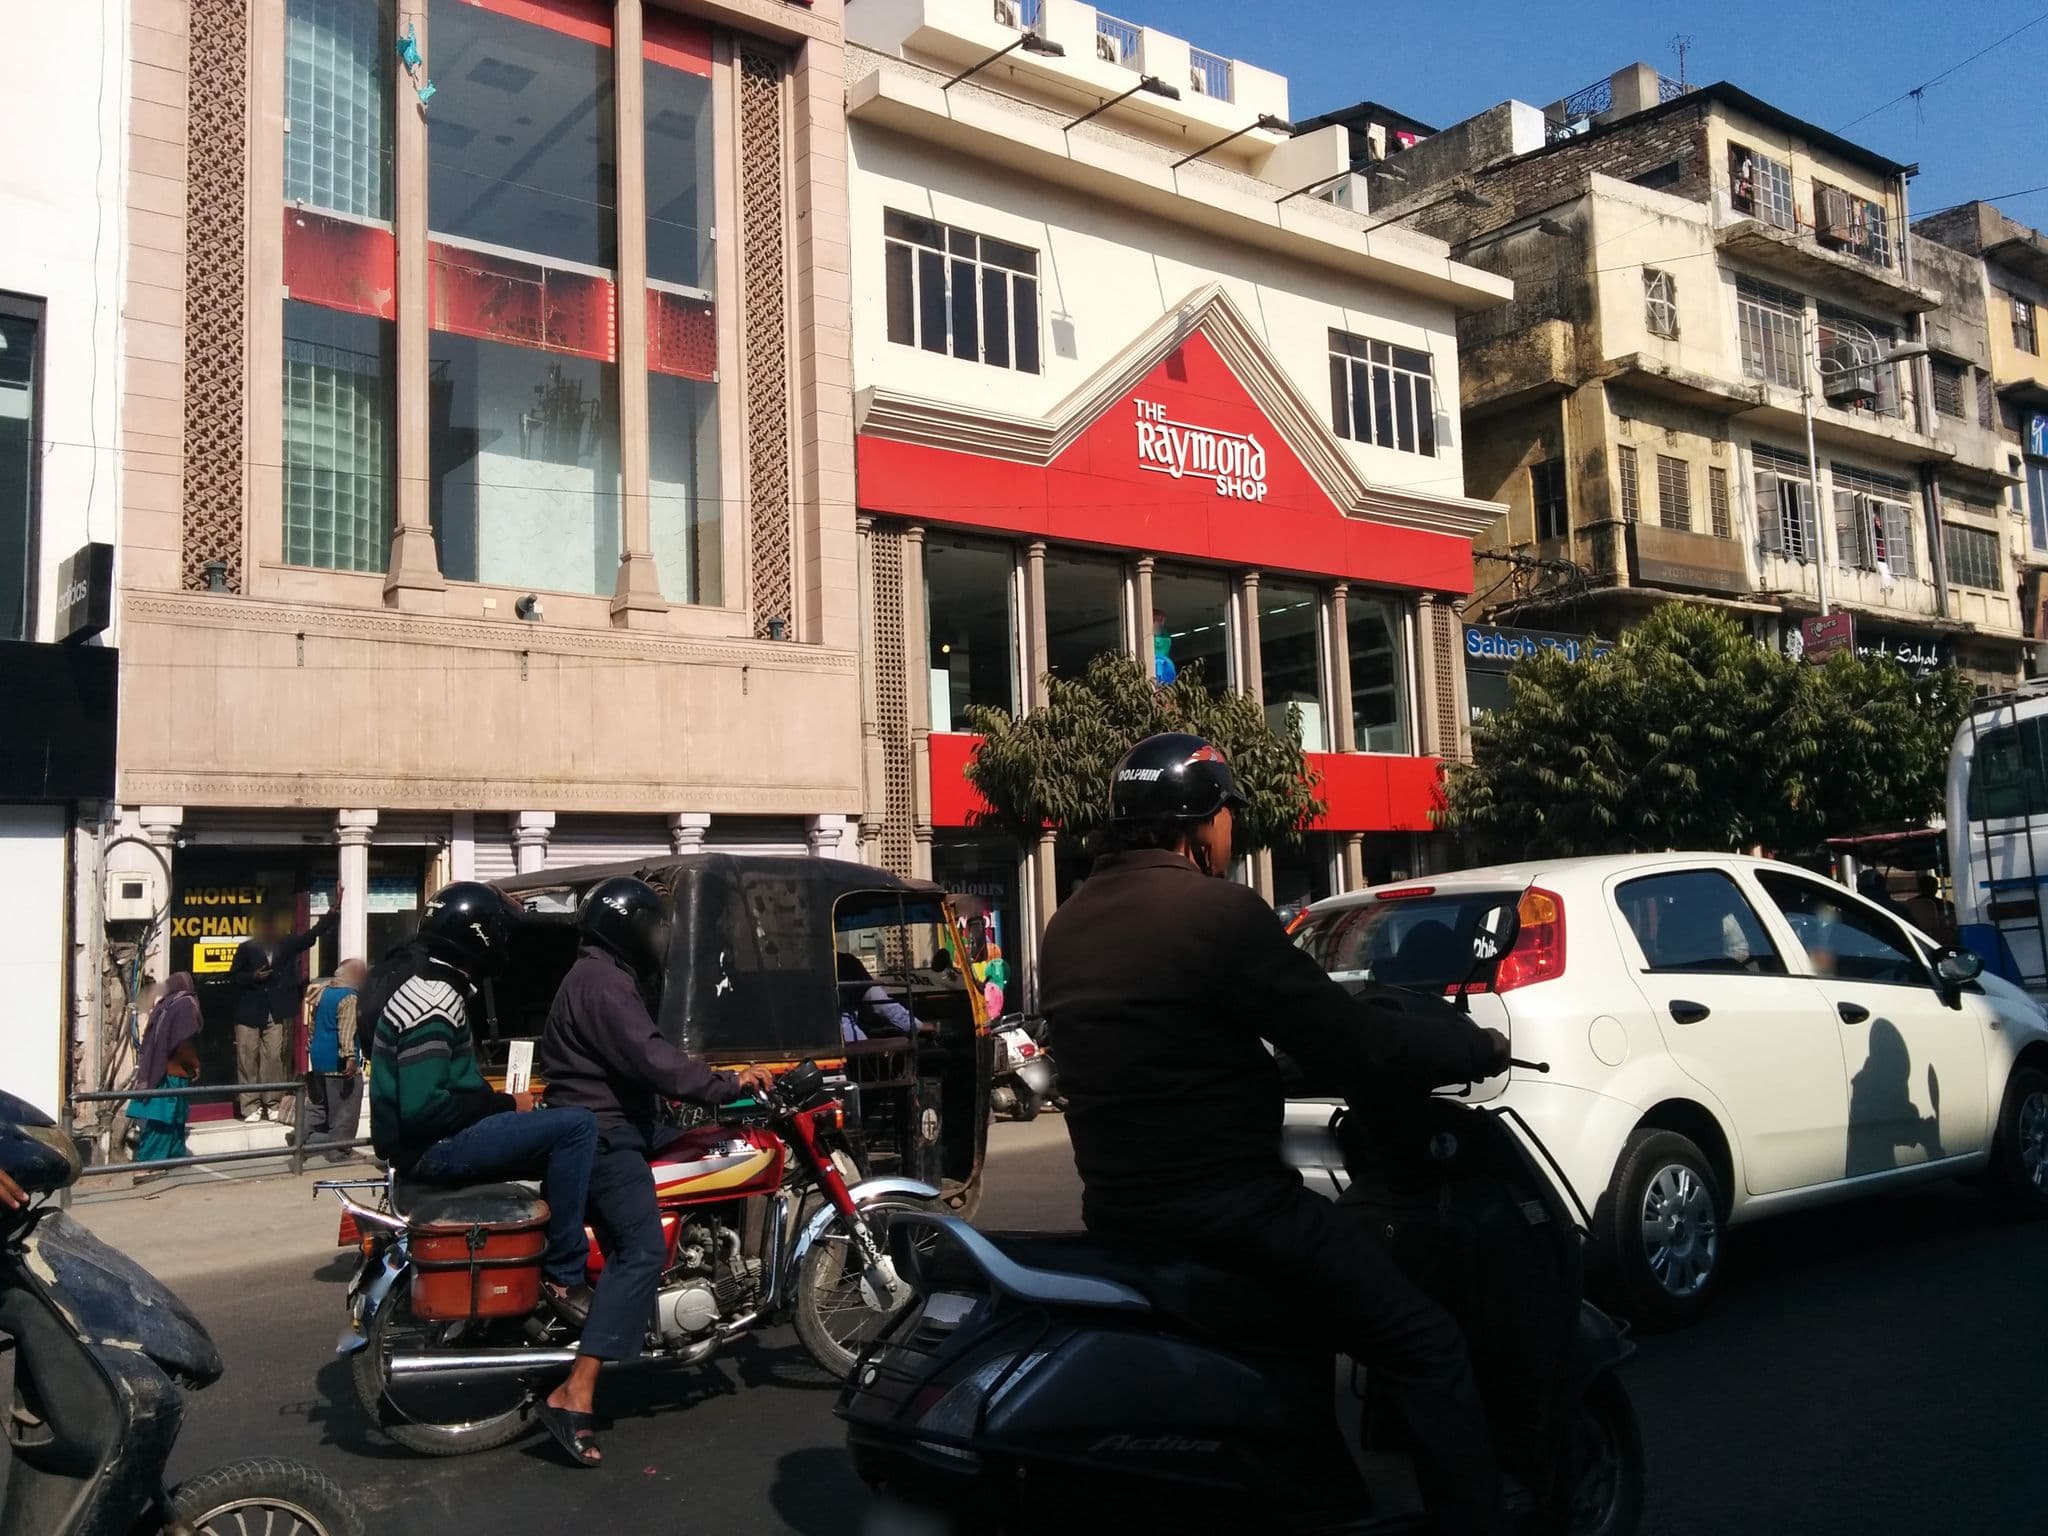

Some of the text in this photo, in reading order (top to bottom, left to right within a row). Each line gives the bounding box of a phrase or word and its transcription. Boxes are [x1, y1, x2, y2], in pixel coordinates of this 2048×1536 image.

[1133, 398, 1167, 423] THE
[1135, 420, 1266, 481] Raymond
[1216, 474, 1268, 502] SHOP
[57, 579, 88, 613] adidas
[1466, 629, 1538, 658] Sahab
[1895, 643, 1939, 677] Sahab
[1118, 768, 1164, 782] DOLPHIN
[184, 888, 266, 905] MONEY
[1088, 1434, 1222, 1451] Activa
